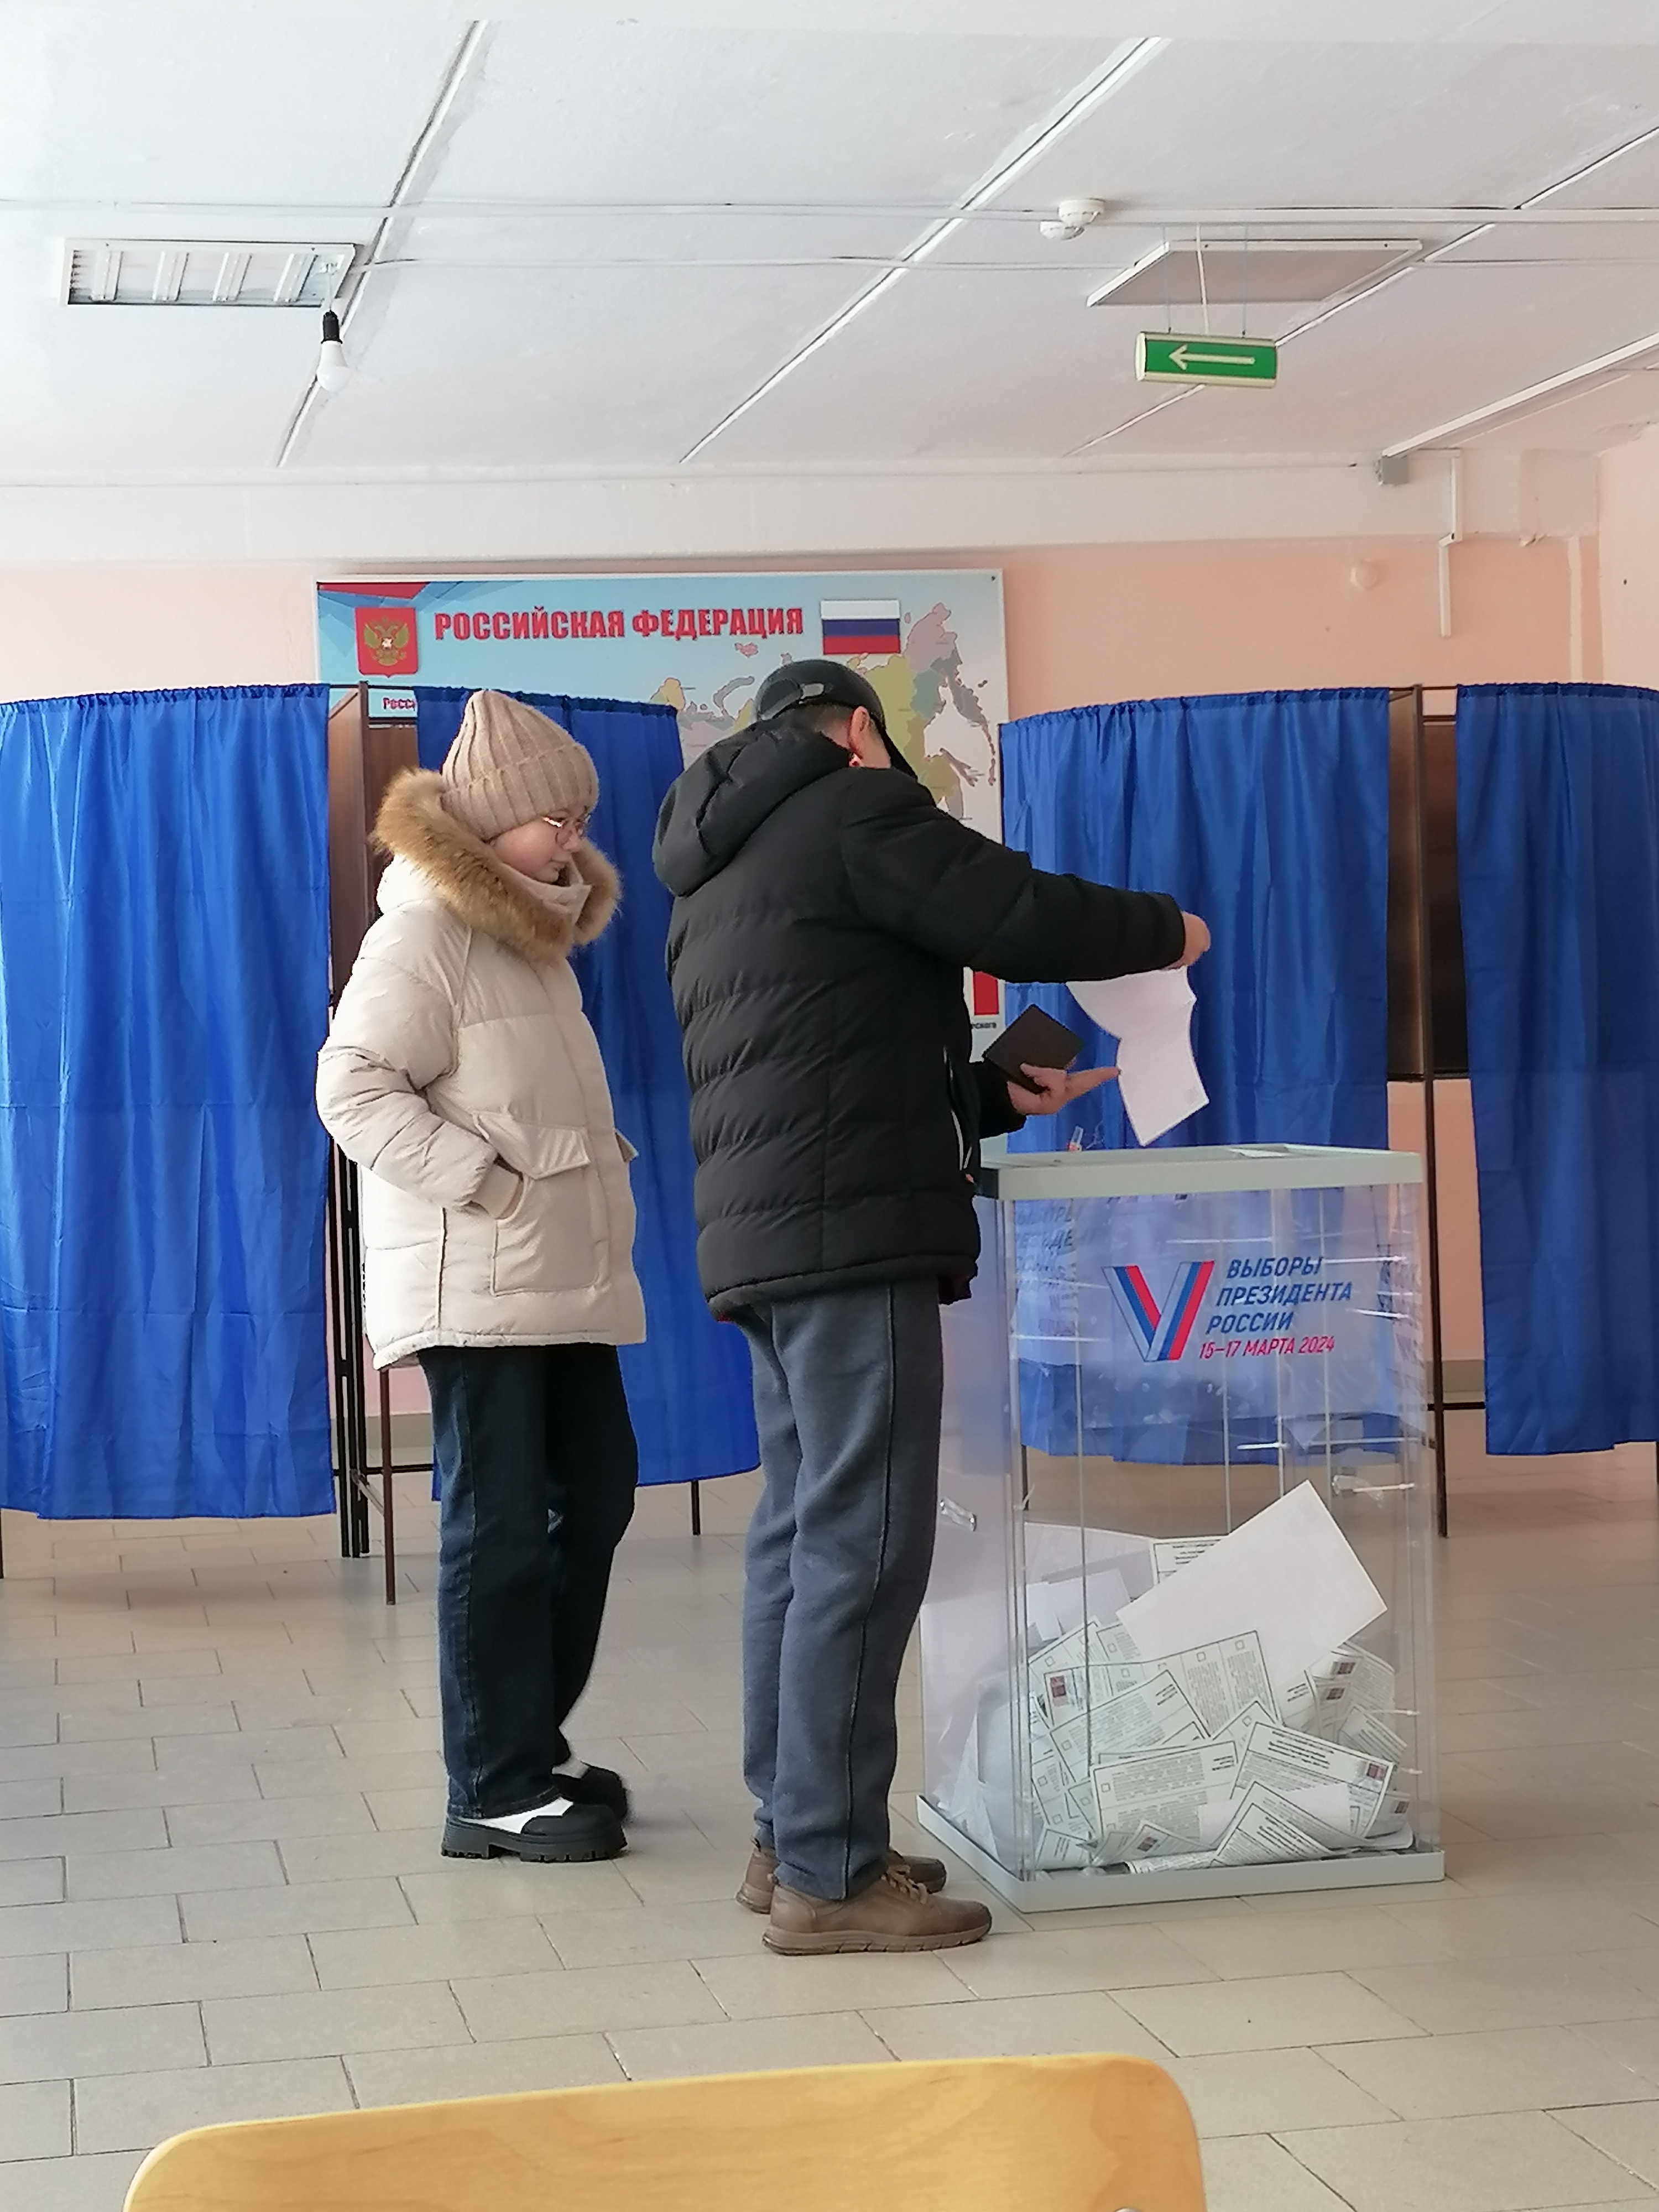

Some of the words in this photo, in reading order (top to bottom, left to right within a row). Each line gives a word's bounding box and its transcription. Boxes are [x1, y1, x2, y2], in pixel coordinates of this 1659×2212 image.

[434, 606, 625, 640] РОССИЙСКАЯ
[632, 608, 804, 641] ФЕДЕРАЦИЯ
[1225, 1255, 1323, 1279] ВЫБОРЫ
[1215, 1281, 1353, 1307] ПРЕЗИДЕНТА
[1205, 1311, 1295, 1335] РОССИИ
[1242, 1337, 1295, 1357] МАРТА
[1298, 1335, 1335, 1354] 2024
